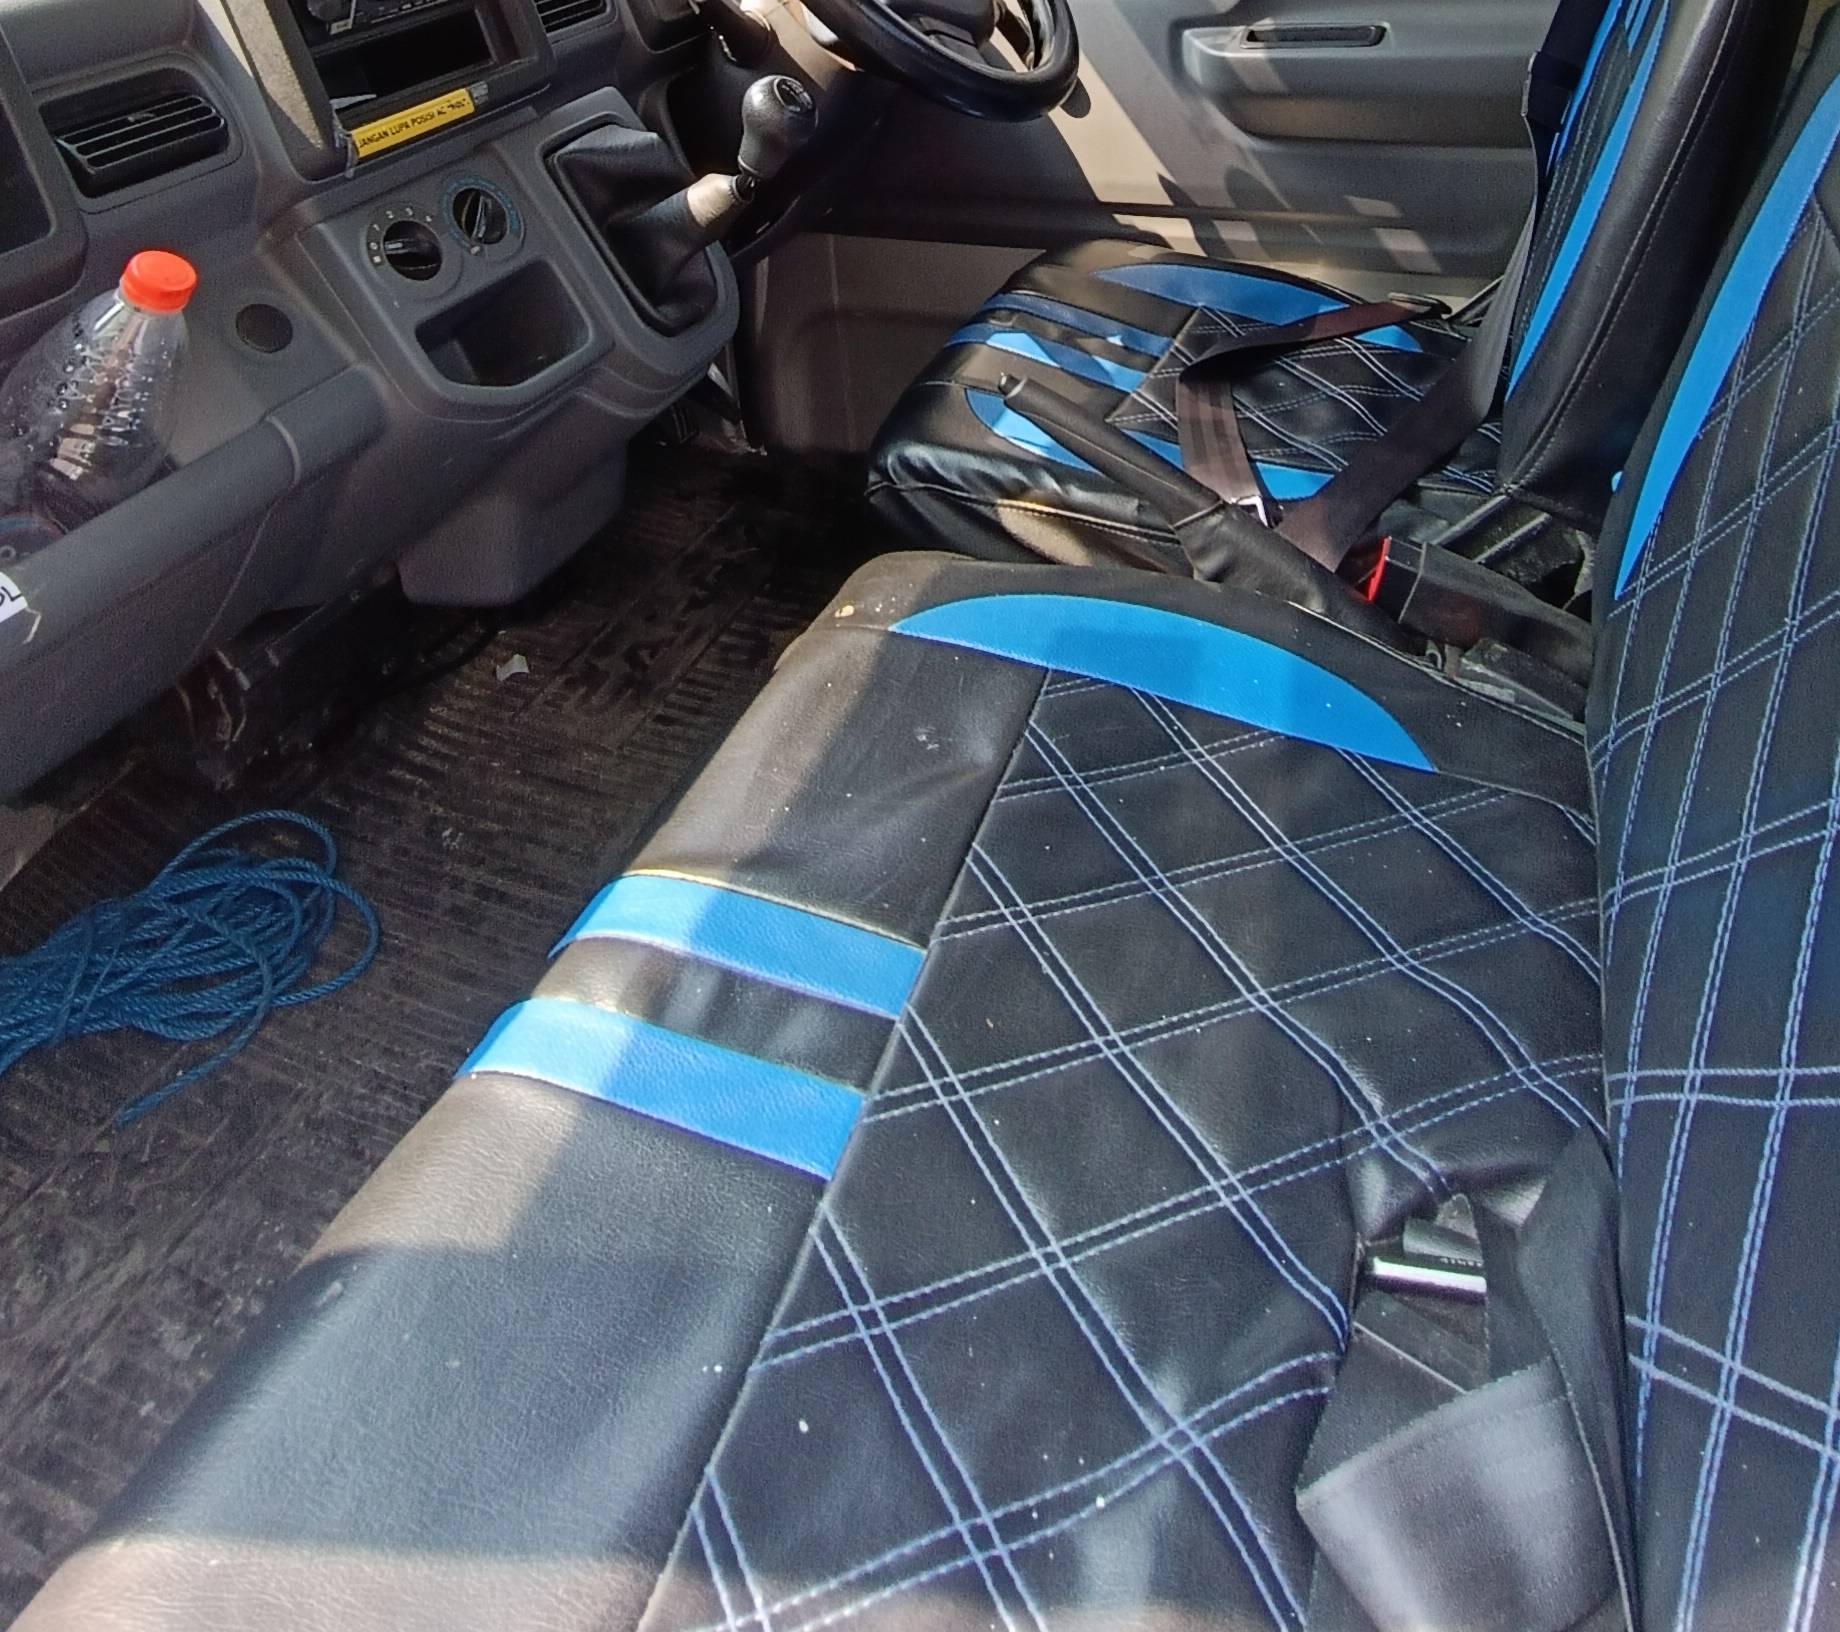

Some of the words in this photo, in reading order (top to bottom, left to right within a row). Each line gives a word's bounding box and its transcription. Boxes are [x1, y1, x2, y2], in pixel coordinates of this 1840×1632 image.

[358, 130, 389, 148] JANGAN
[390, 121, 409, 136] LUPA
[411, 111, 435, 127] POSISI
